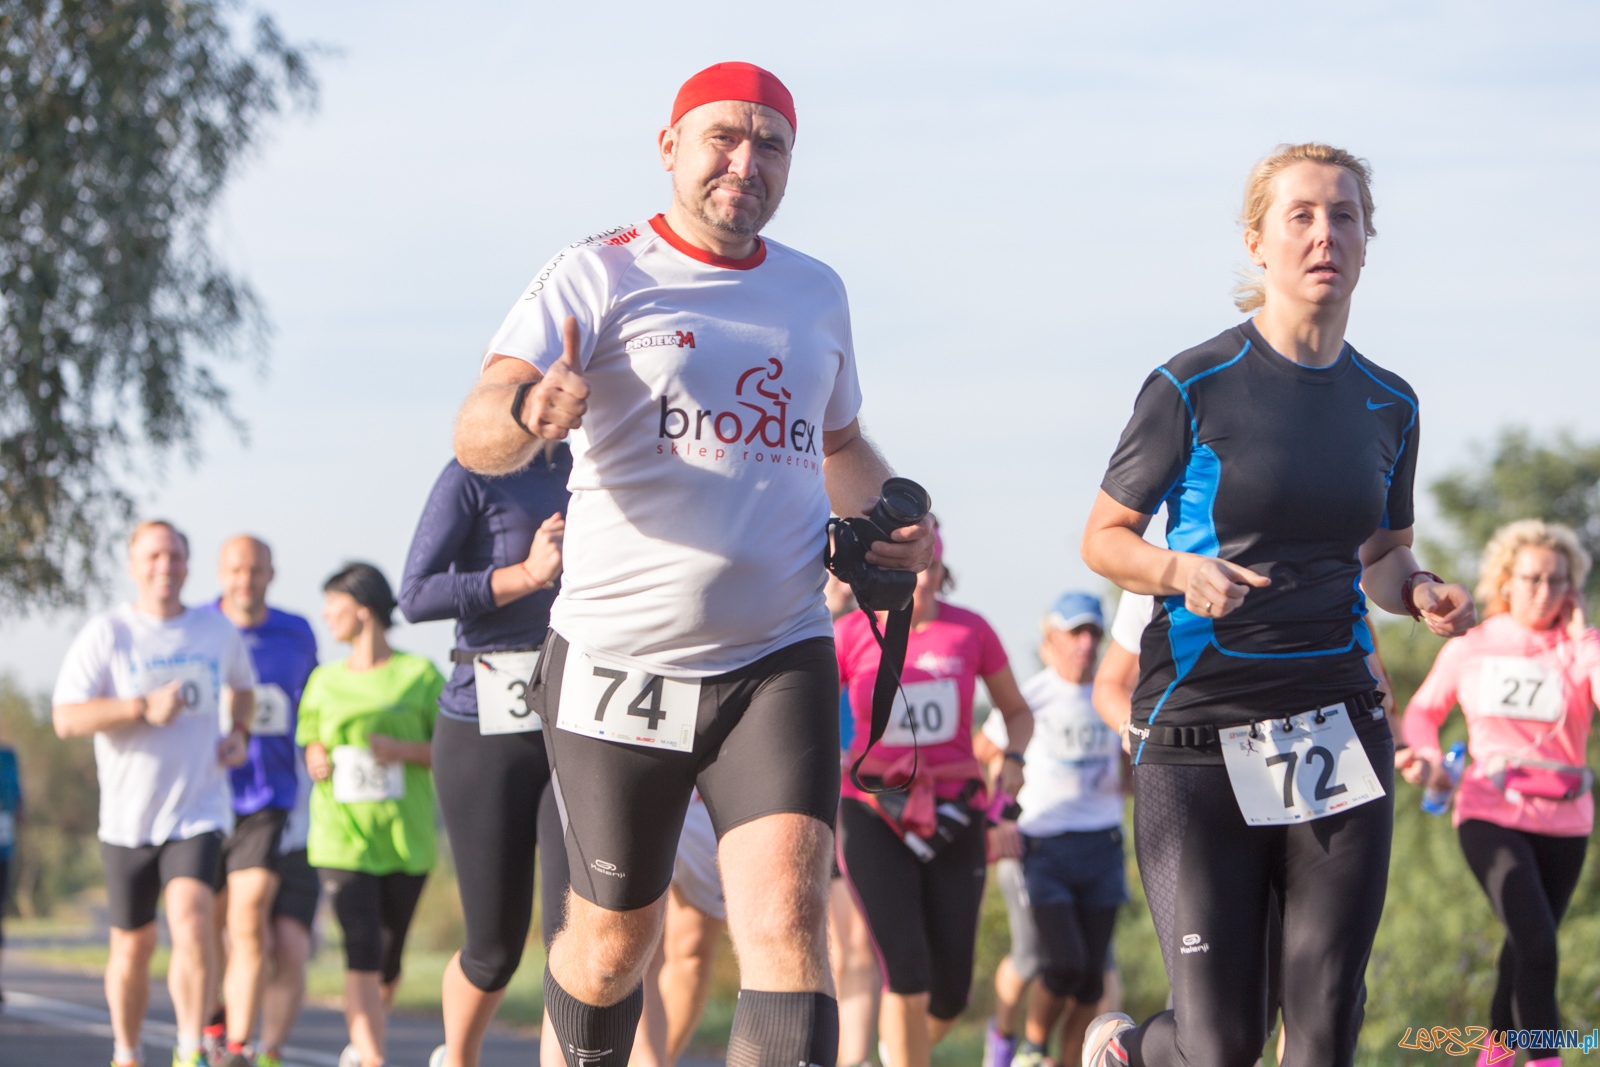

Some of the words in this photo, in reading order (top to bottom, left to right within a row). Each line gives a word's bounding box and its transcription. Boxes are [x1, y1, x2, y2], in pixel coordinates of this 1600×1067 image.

[656, 442, 725, 461] sklep
[592, 666, 667, 731] 74
[1501, 677, 1544, 707] 27
[899, 702, 943, 733] 40
[1265, 745, 1349, 809] 72
